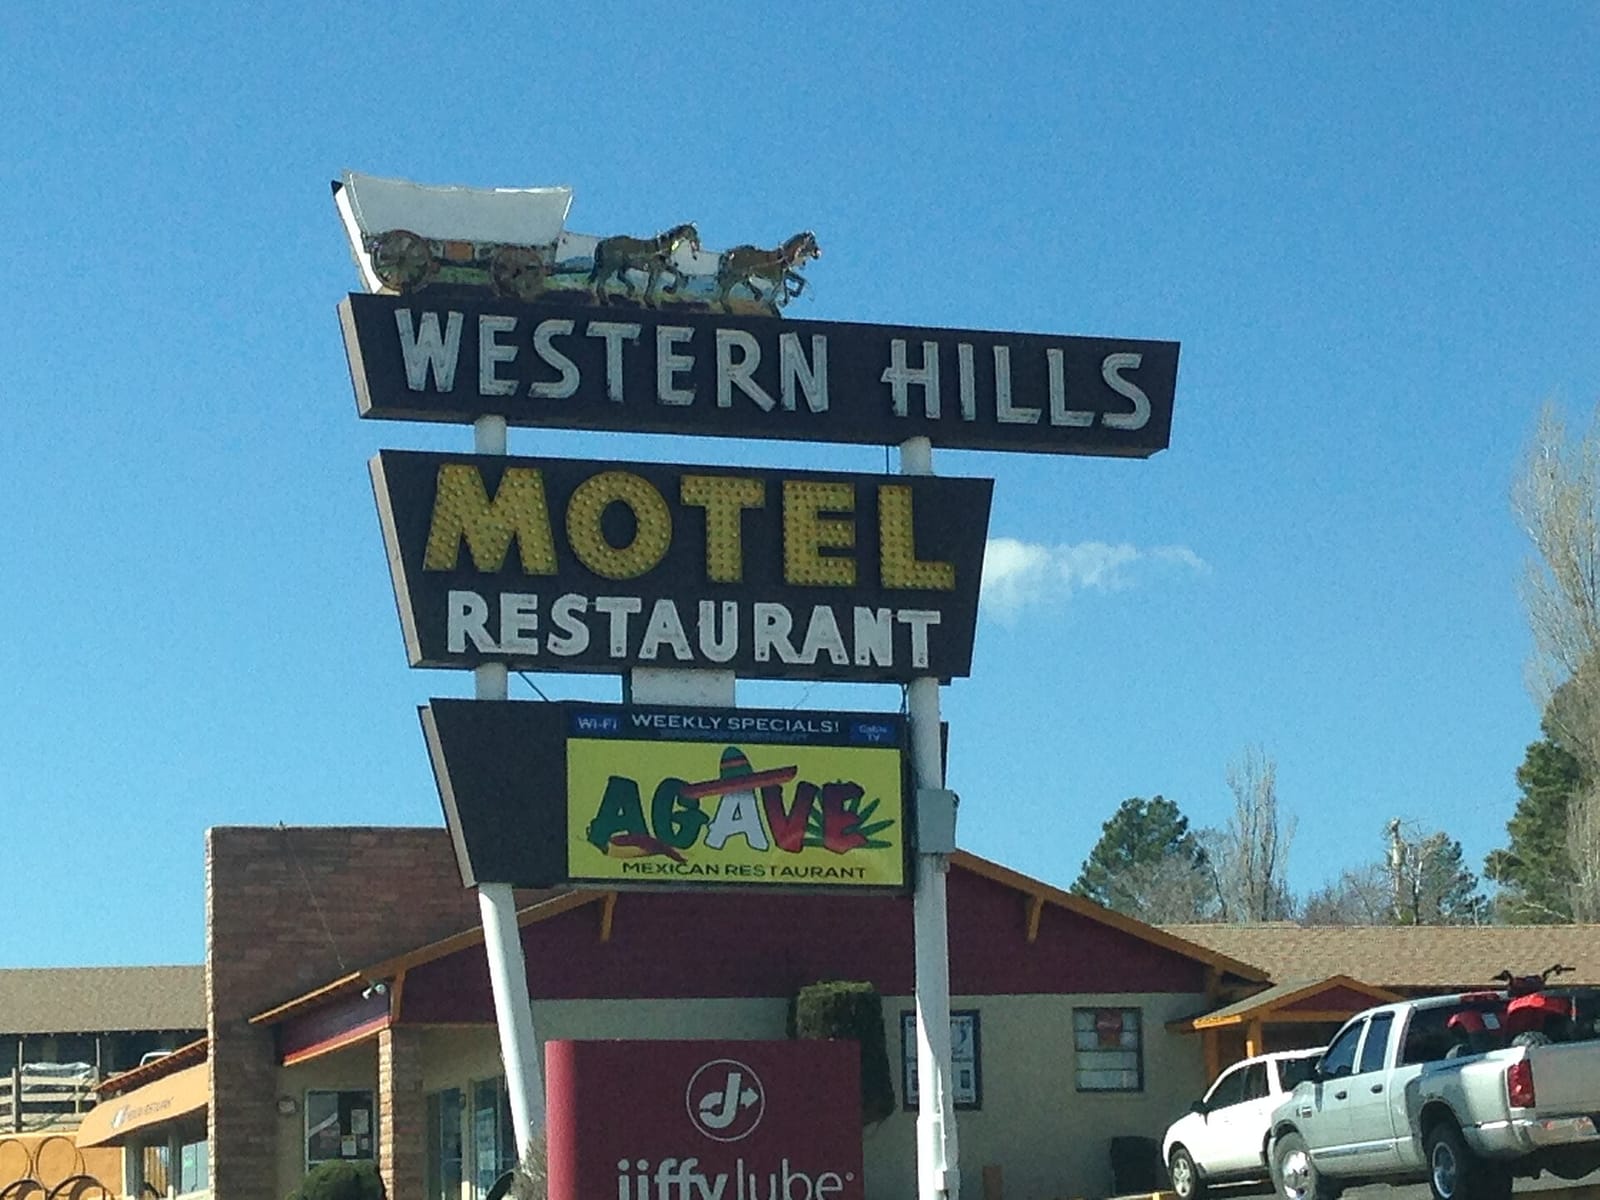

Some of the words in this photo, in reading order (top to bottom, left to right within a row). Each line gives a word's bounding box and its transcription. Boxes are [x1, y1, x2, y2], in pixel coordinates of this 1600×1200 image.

[394, 308, 829, 413] WESTERN
[881, 339, 1151, 430] HILLS
[422, 463, 956, 592] MOTEL
[447, 590, 942, 669] RESTAURANT
[631, 713, 722, 730] WEEKLY
[727, 717, 840, 733] SPECIALS!
[586, 775, 869, 855] AGAVE
[622, 861, 720, 877] MEXICAN
[725, 864, 867, 879] RESTAURANT
